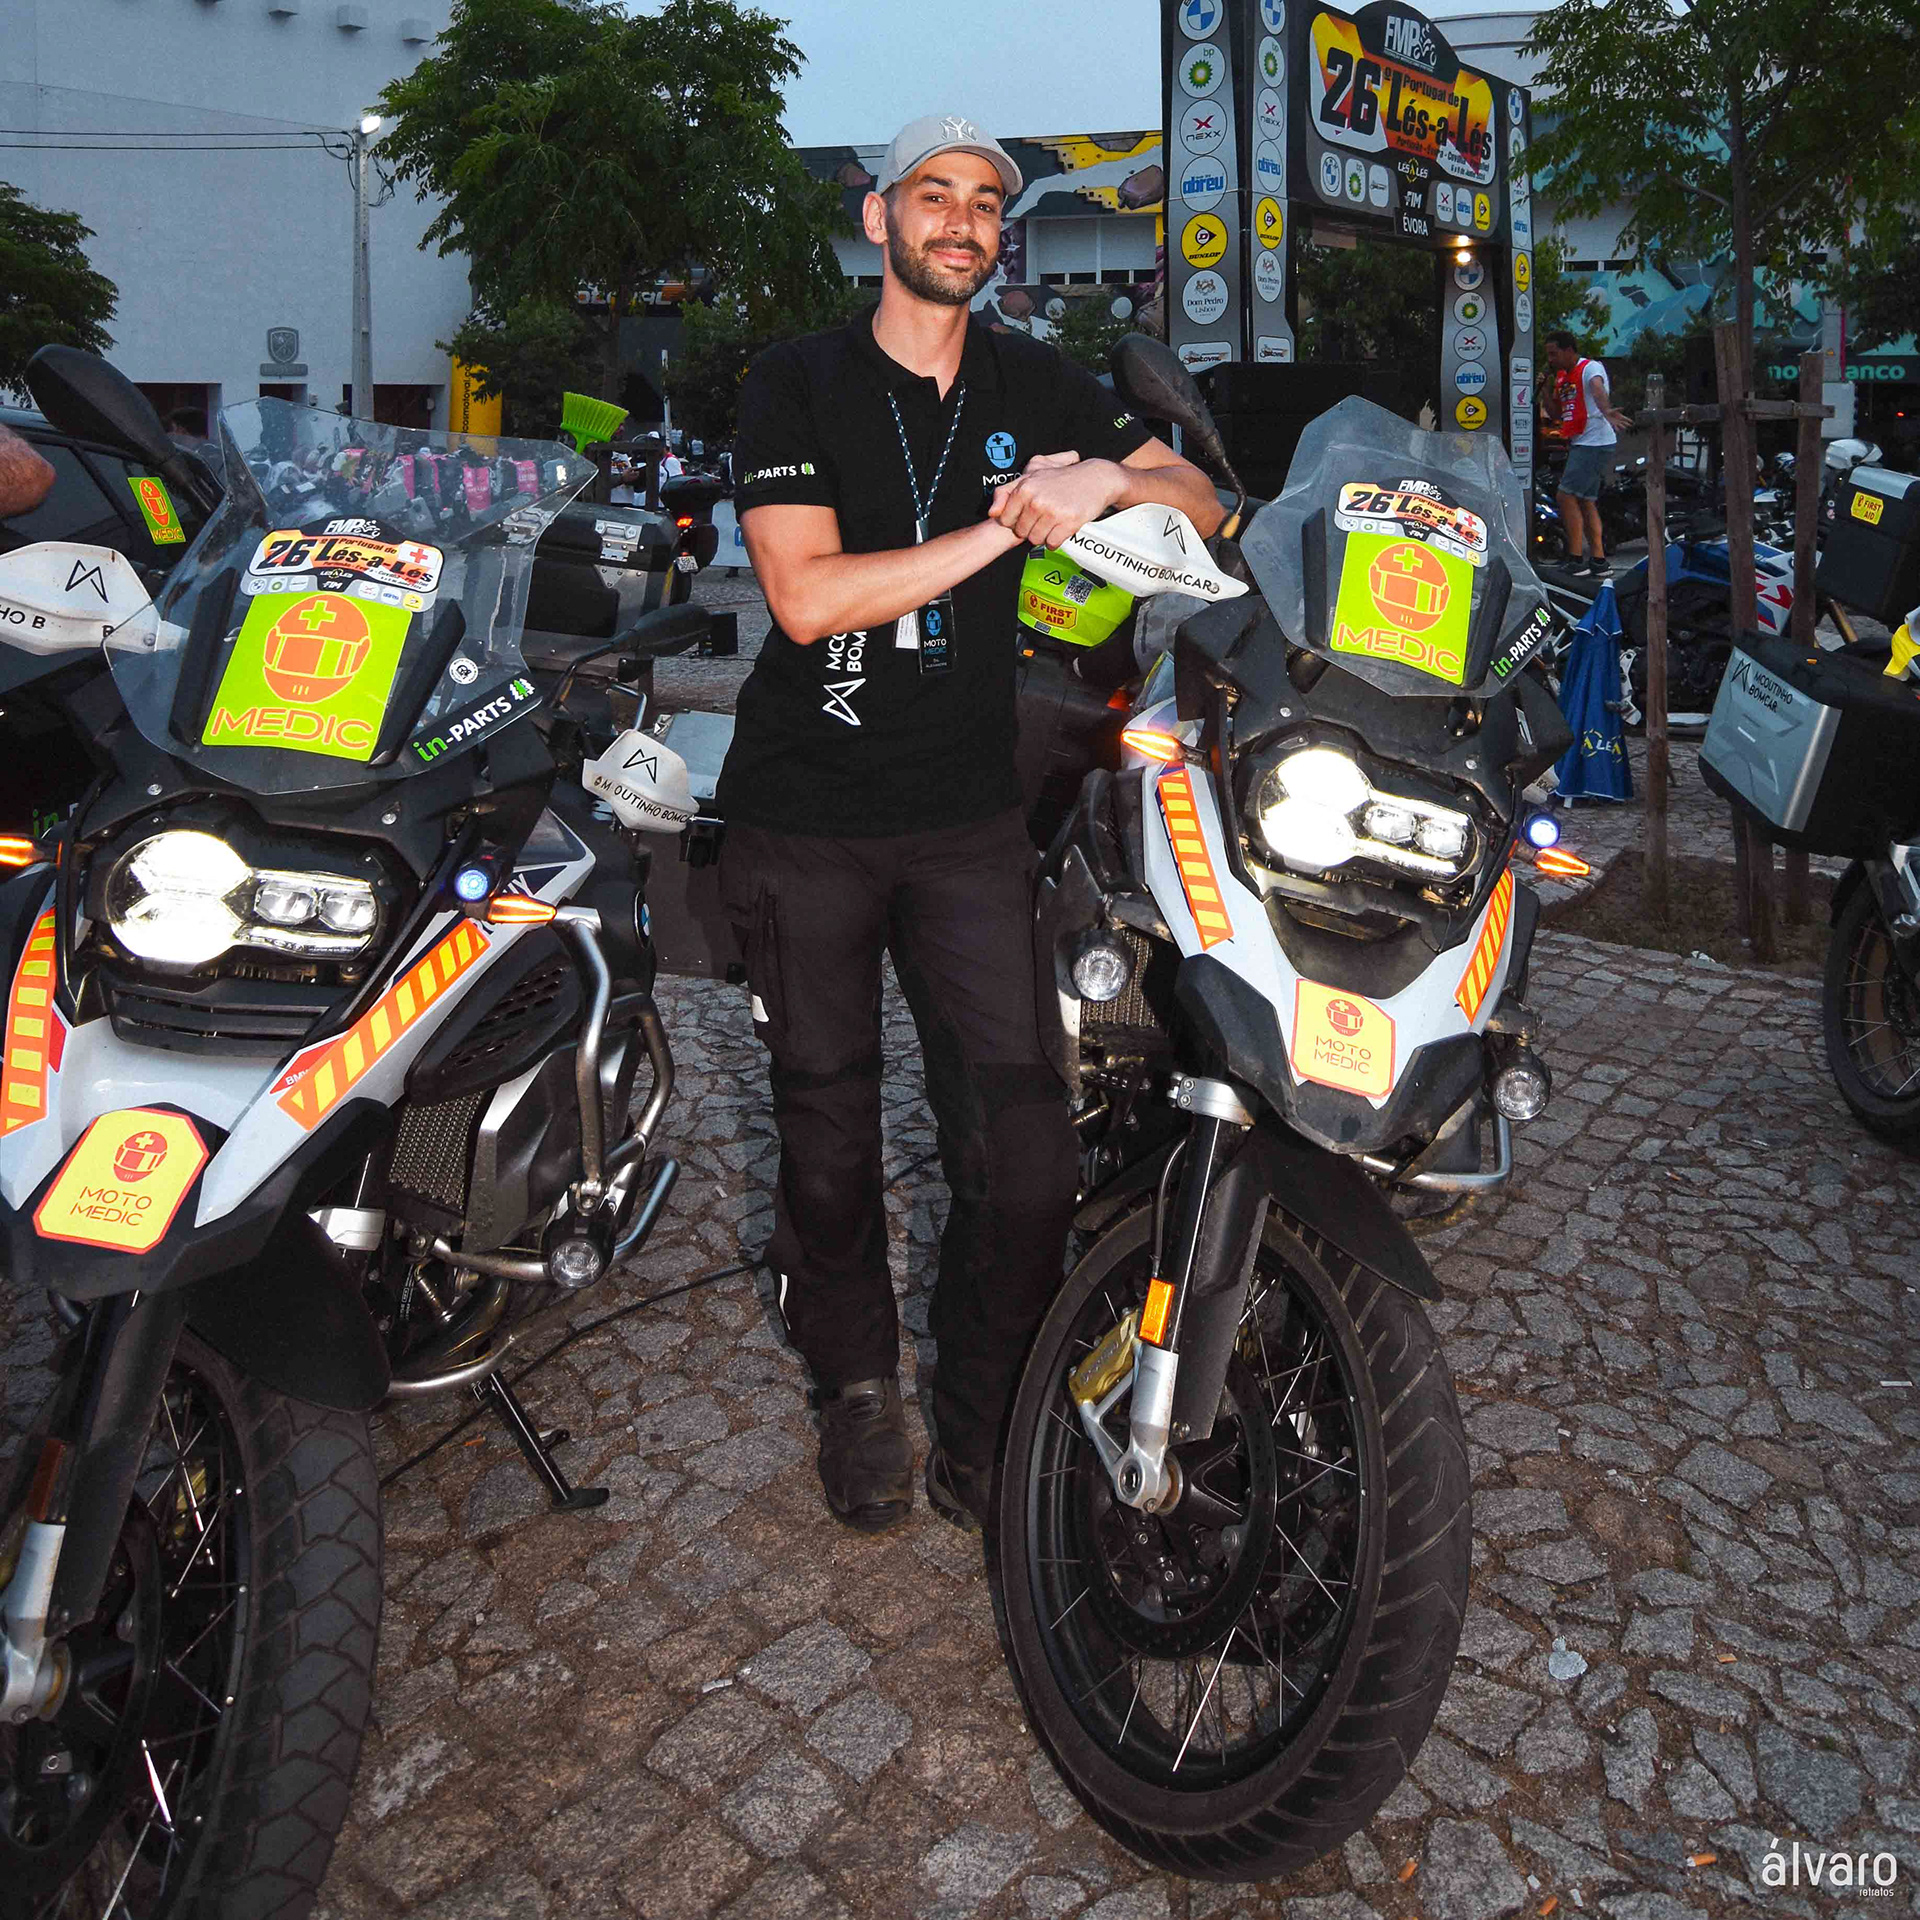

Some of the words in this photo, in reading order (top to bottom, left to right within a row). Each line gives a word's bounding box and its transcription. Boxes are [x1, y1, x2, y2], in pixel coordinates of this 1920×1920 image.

[1385, 15, 1421, 57] FMP
[1203, 48, 1215, 58] bp
[1402, 74, 1447, 103] Portugal
[1448, 91, 1460, 108] de
[1387, 70, 1492, 161] Lés-a-Lés
[1182, 176, 1225, 195] abreu
[1402, 213, 1429, 236] ÉVORA
[1188, 251, 1221, 260] DUNLOP
[1187, 299, 1204, 308] Dom
[1204, 297, 1224, 307] Pedro
[1768, 364, 1906, 381] noanco
[744, 465, 797, 484] in-PARTS
[1864, 500, 1881, 511] FIRST
[338, 538, 384, 552] Portugal
[384, 547, 398, 555] de
[315, 538, 434, 582] Lés-a-Lés
[1040, 603, 1072, 618] FIRST
[1045, 615, 1065, 625] AID
[923, 638, 947, 648] MOTO
[1336, 623, 1460, 677] MEDIC
[1490, 622, 1542, 679] in-PARTS
[1748, 684, 1778, 713] BOMCAR
[211, 706, 374, 750] MEDIC
[413, 696, 512, 762] in-PARTS
[1315, 1035, 1372, 1060] MOTO
[1313, 1048, 1371, 1075] MEDIC
[80, 1186, 152, 1210] MOTO
[70, 1203, 143, 1226] MEDIC
